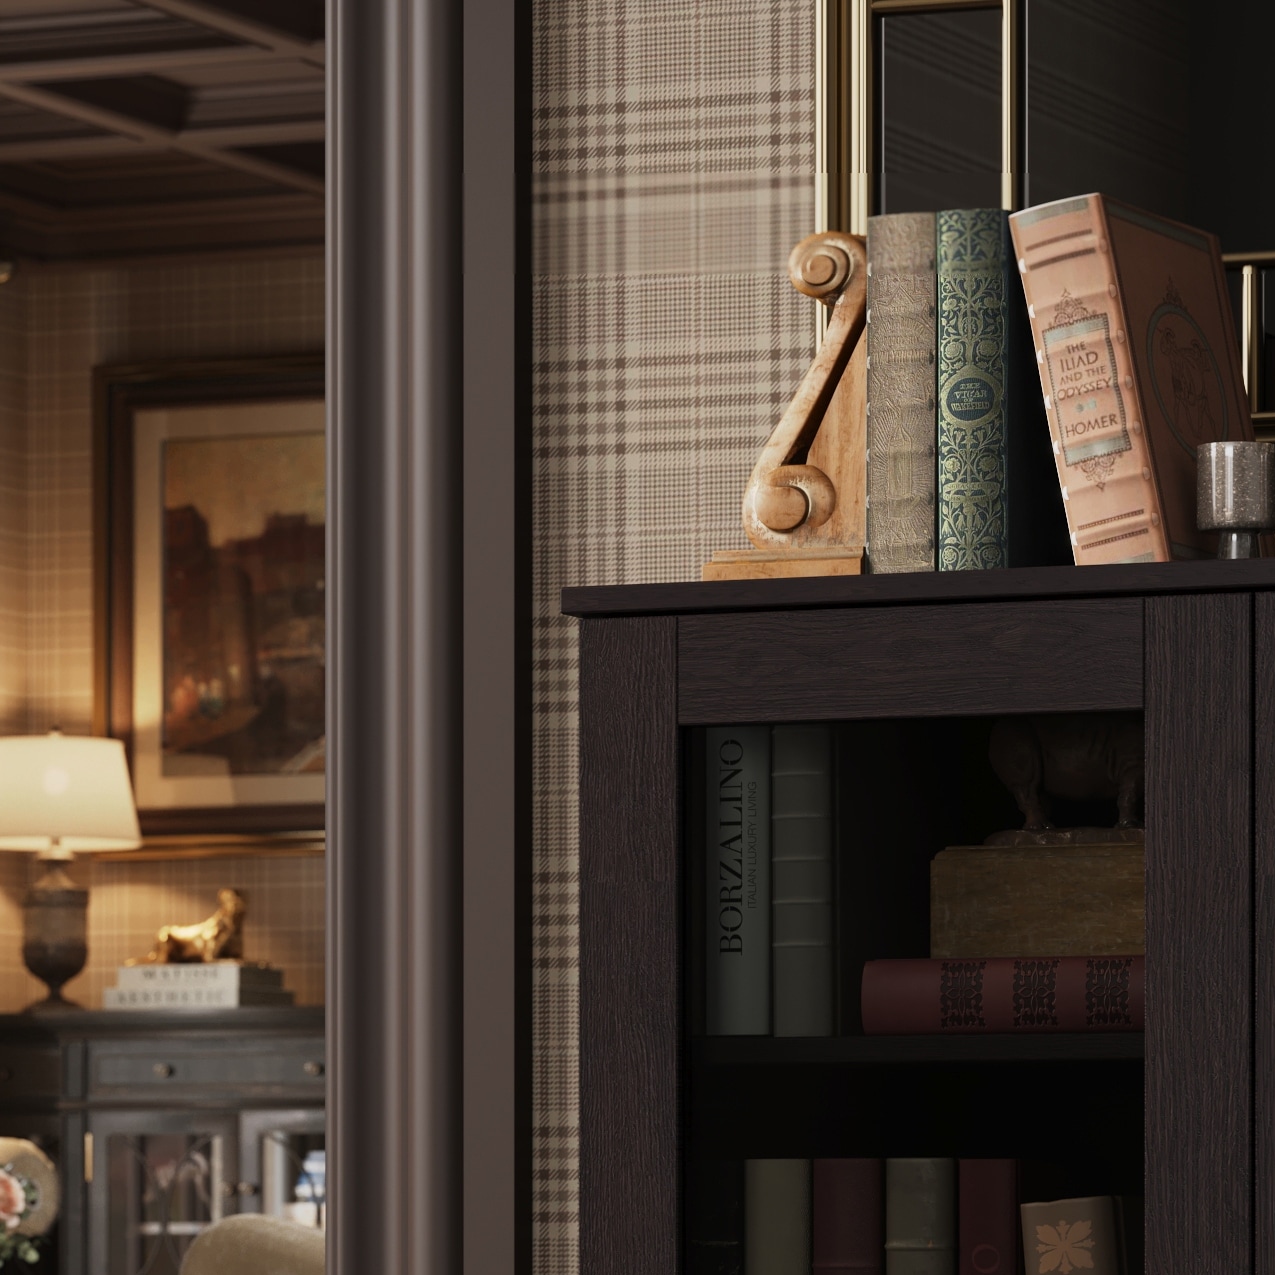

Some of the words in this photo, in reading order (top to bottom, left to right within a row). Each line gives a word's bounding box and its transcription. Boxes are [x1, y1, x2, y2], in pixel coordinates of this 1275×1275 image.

[1067, 341, 1087, 354] THE
[1060, 351, 1098, 373] ILIAD
[1060, 371, 1082, 386] AND
[1085, 365, 1106, 379] THE
[1057, 377, 1111, 401] ODYSSEY
[1065, 413, 1118, 437] HOMER
[747, 781, 757, 817] LIVING
[719, 739, 744, 956] BORZALINO
[747, 821, 757, 865] LUXURY
[747, 868, 757, 909] ITALIAN
